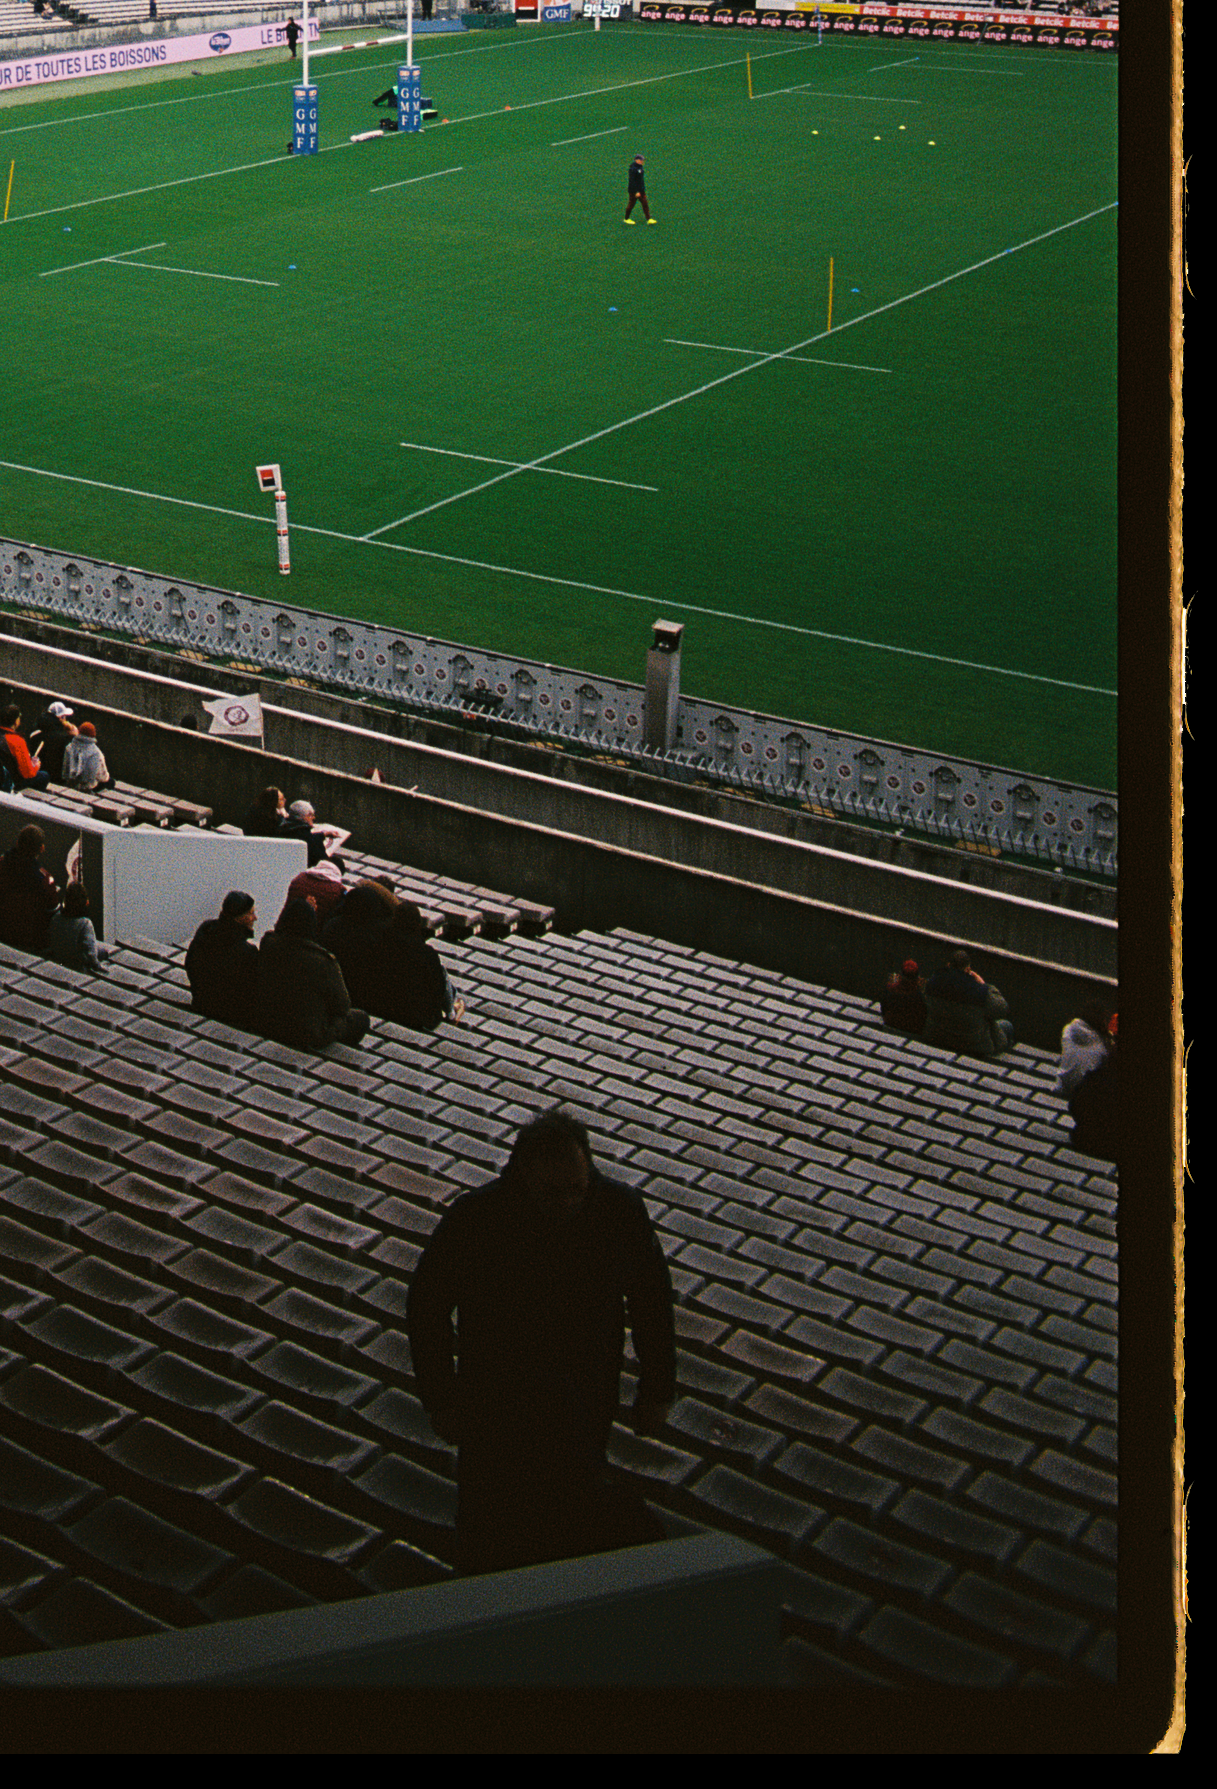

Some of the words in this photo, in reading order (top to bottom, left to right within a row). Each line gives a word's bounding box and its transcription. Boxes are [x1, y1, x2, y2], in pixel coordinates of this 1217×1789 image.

[545, 8, 569, 19] GMF
[261, 29, 273, 45] LE
[641, 11, 662, 20] ange
[665, 11, 686, 21] ange
[689, 13, 710, 23] ange
[713, 15, 734, 24] ange
[737, 16, 758, 26] ange
[761, 17, 782, 27] ange
[785, 18, 806, 28] ange
[833, 21, 855, 31] ange
[858, 23, 879, 33] ange
[883, 24, 905, 34] ange
[908, 26, 930, 36] ange
[932, 28, 955, 38] ange
[958, 30, 981, 39] ange
[984, 32, 1007, 41] ange
[1010, 33, 1033, 43] ange
[1037, 35, 1060, 45] ange
[1064, 37, 1087, 47] ange
[1091, 39, 1115, 49] ange
[16, 64, 32, 83] DE
[34, 57, 82, 79] TOUTES
[85, 53, 106, 71] LES
[110, 45, 167, 68] BOISSONS
